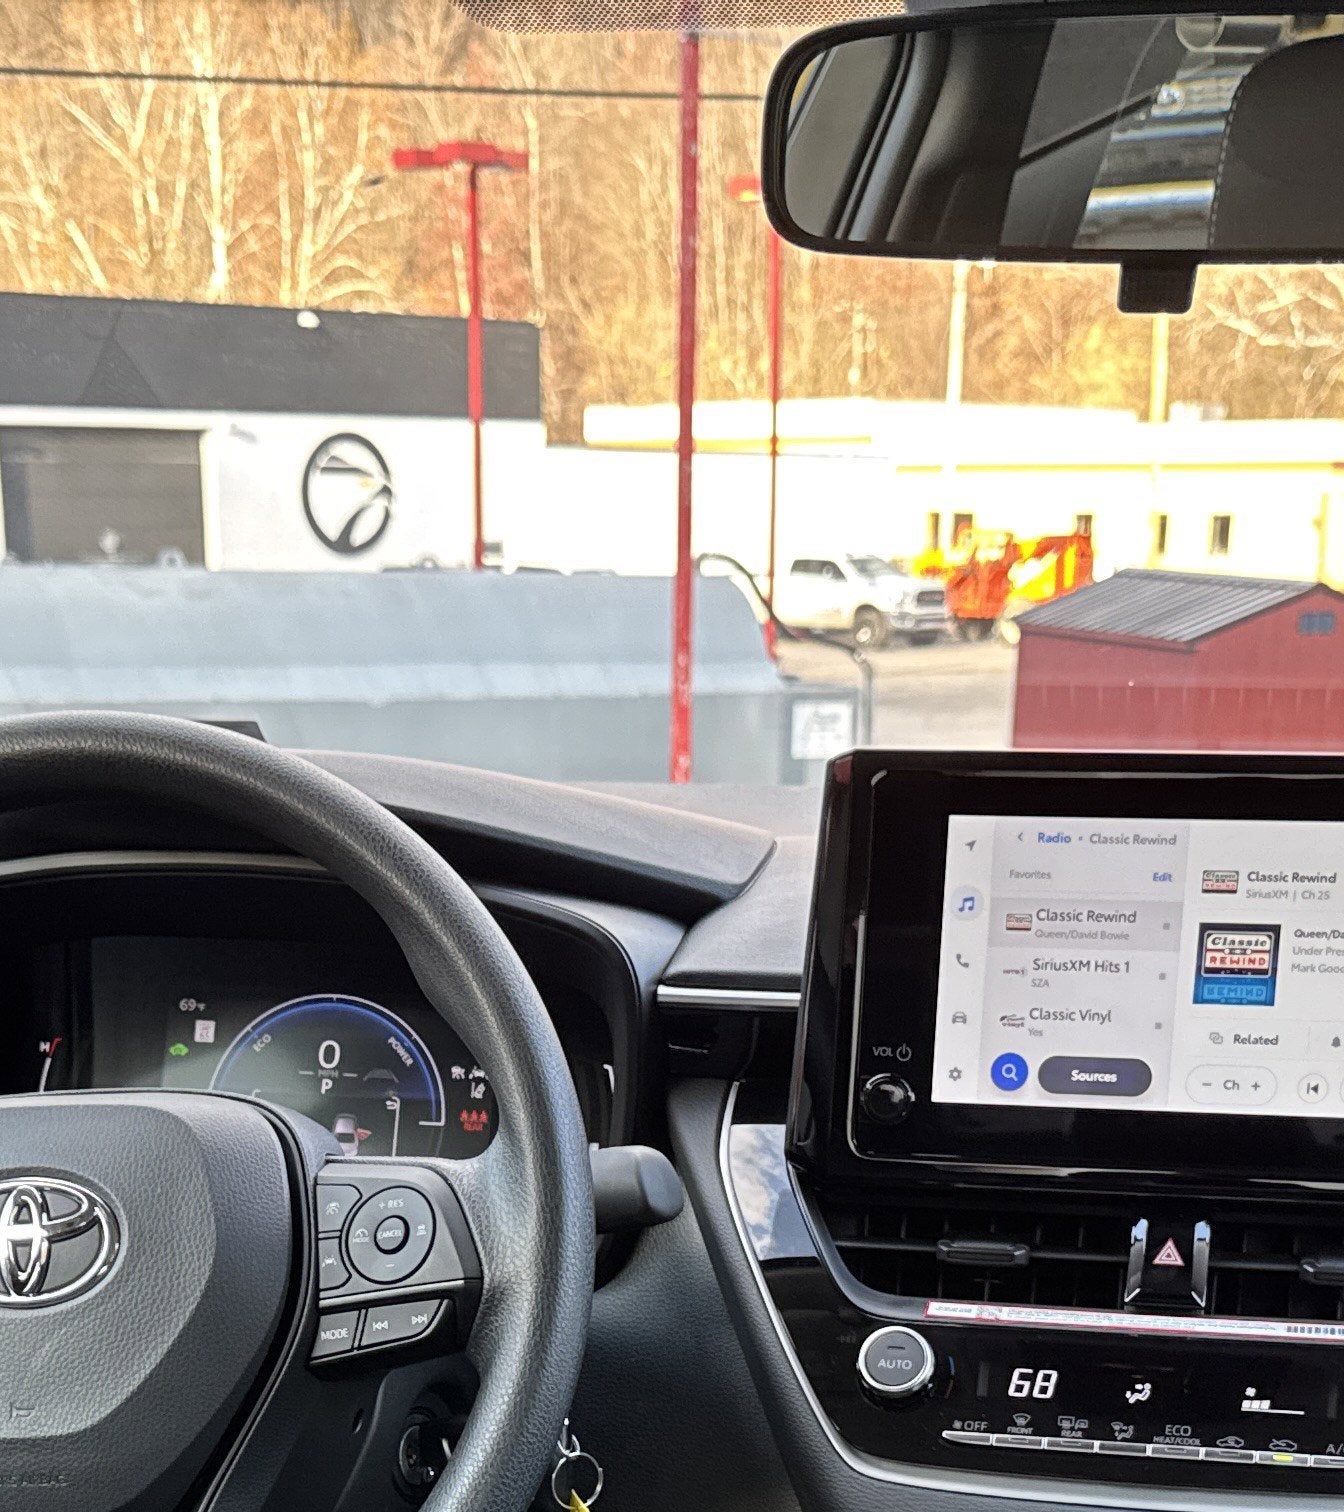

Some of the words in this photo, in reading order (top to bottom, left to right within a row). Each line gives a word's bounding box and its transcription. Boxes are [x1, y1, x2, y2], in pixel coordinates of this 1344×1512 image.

[1037, 832, 1072, 844] Radio
[1089, 834, 1130, 845] Classic
[1132, 834, 1178, 846] Rewind
[1009, 869, 1052, 880] Favorites
[1152, 872, 1174, 882] Edit
[1247, 871, 1289, 883] Classic
[1292, 872, 1338, 884] Rewind
[1246, 889, 1289, 899] SiriusXM
[1301, 889, 1315, 899] Ch
[1036, 909, 1083, 922] Classic
[1086, 910, 1137, 924] Rewind
[1034, 929, 1097, 940] Queen/David
[1100, 930, 1130, 940] Bowie
[1211, 936, 1268, 947] Classic
[1292, 946, 1323, 957] Under
[1032, 958, 1091, 973] SiriusXM
[1094, 960, 1121, 973] Hits
[1124, 961, 1131, 973] 1
[1209, 956, 1267, 966] REWIND
[1291, 963, 1316, 973] Mark
[1031, 979, 1050, 988] SZA
[1029, 1008, 1076, 1022] Classic
[1079, 1009, 1112, 1026] Vinyl
[1028, 1028, 1044, 1037] Yes
[252, 1034, 272, 1052] ECO
[1233, 1033, 1280, 1046] Related
[317, 1039, 341, 1069] 0
[387, 1036, 414, 1067] POWER
[872, 1046, 893, 1057] VOL
[1071, 1069, 1118, 1083] Sources
[320, 1078, 333, 1094] P
[1223, 1079, 1240, 1091] Ch
[387, 1199, 404, 1208] RES
[377, 1229, 403, 1239] CANCEL
[321, 1328, 349, 1341] MODE
[877, 1358, 913, 1371] AUTO
[1007, 1367, 1058, 1399] 68
[963, 1420, 988, 1431] OFF
[1006, 1426, 1034, 1435] FRONT
[1165, 1424, 1192, 1437] ECO
[1060, 1429, 1083, 1438] REAR
[1153, 1435, 1202, 1446] HEAT/COOL
